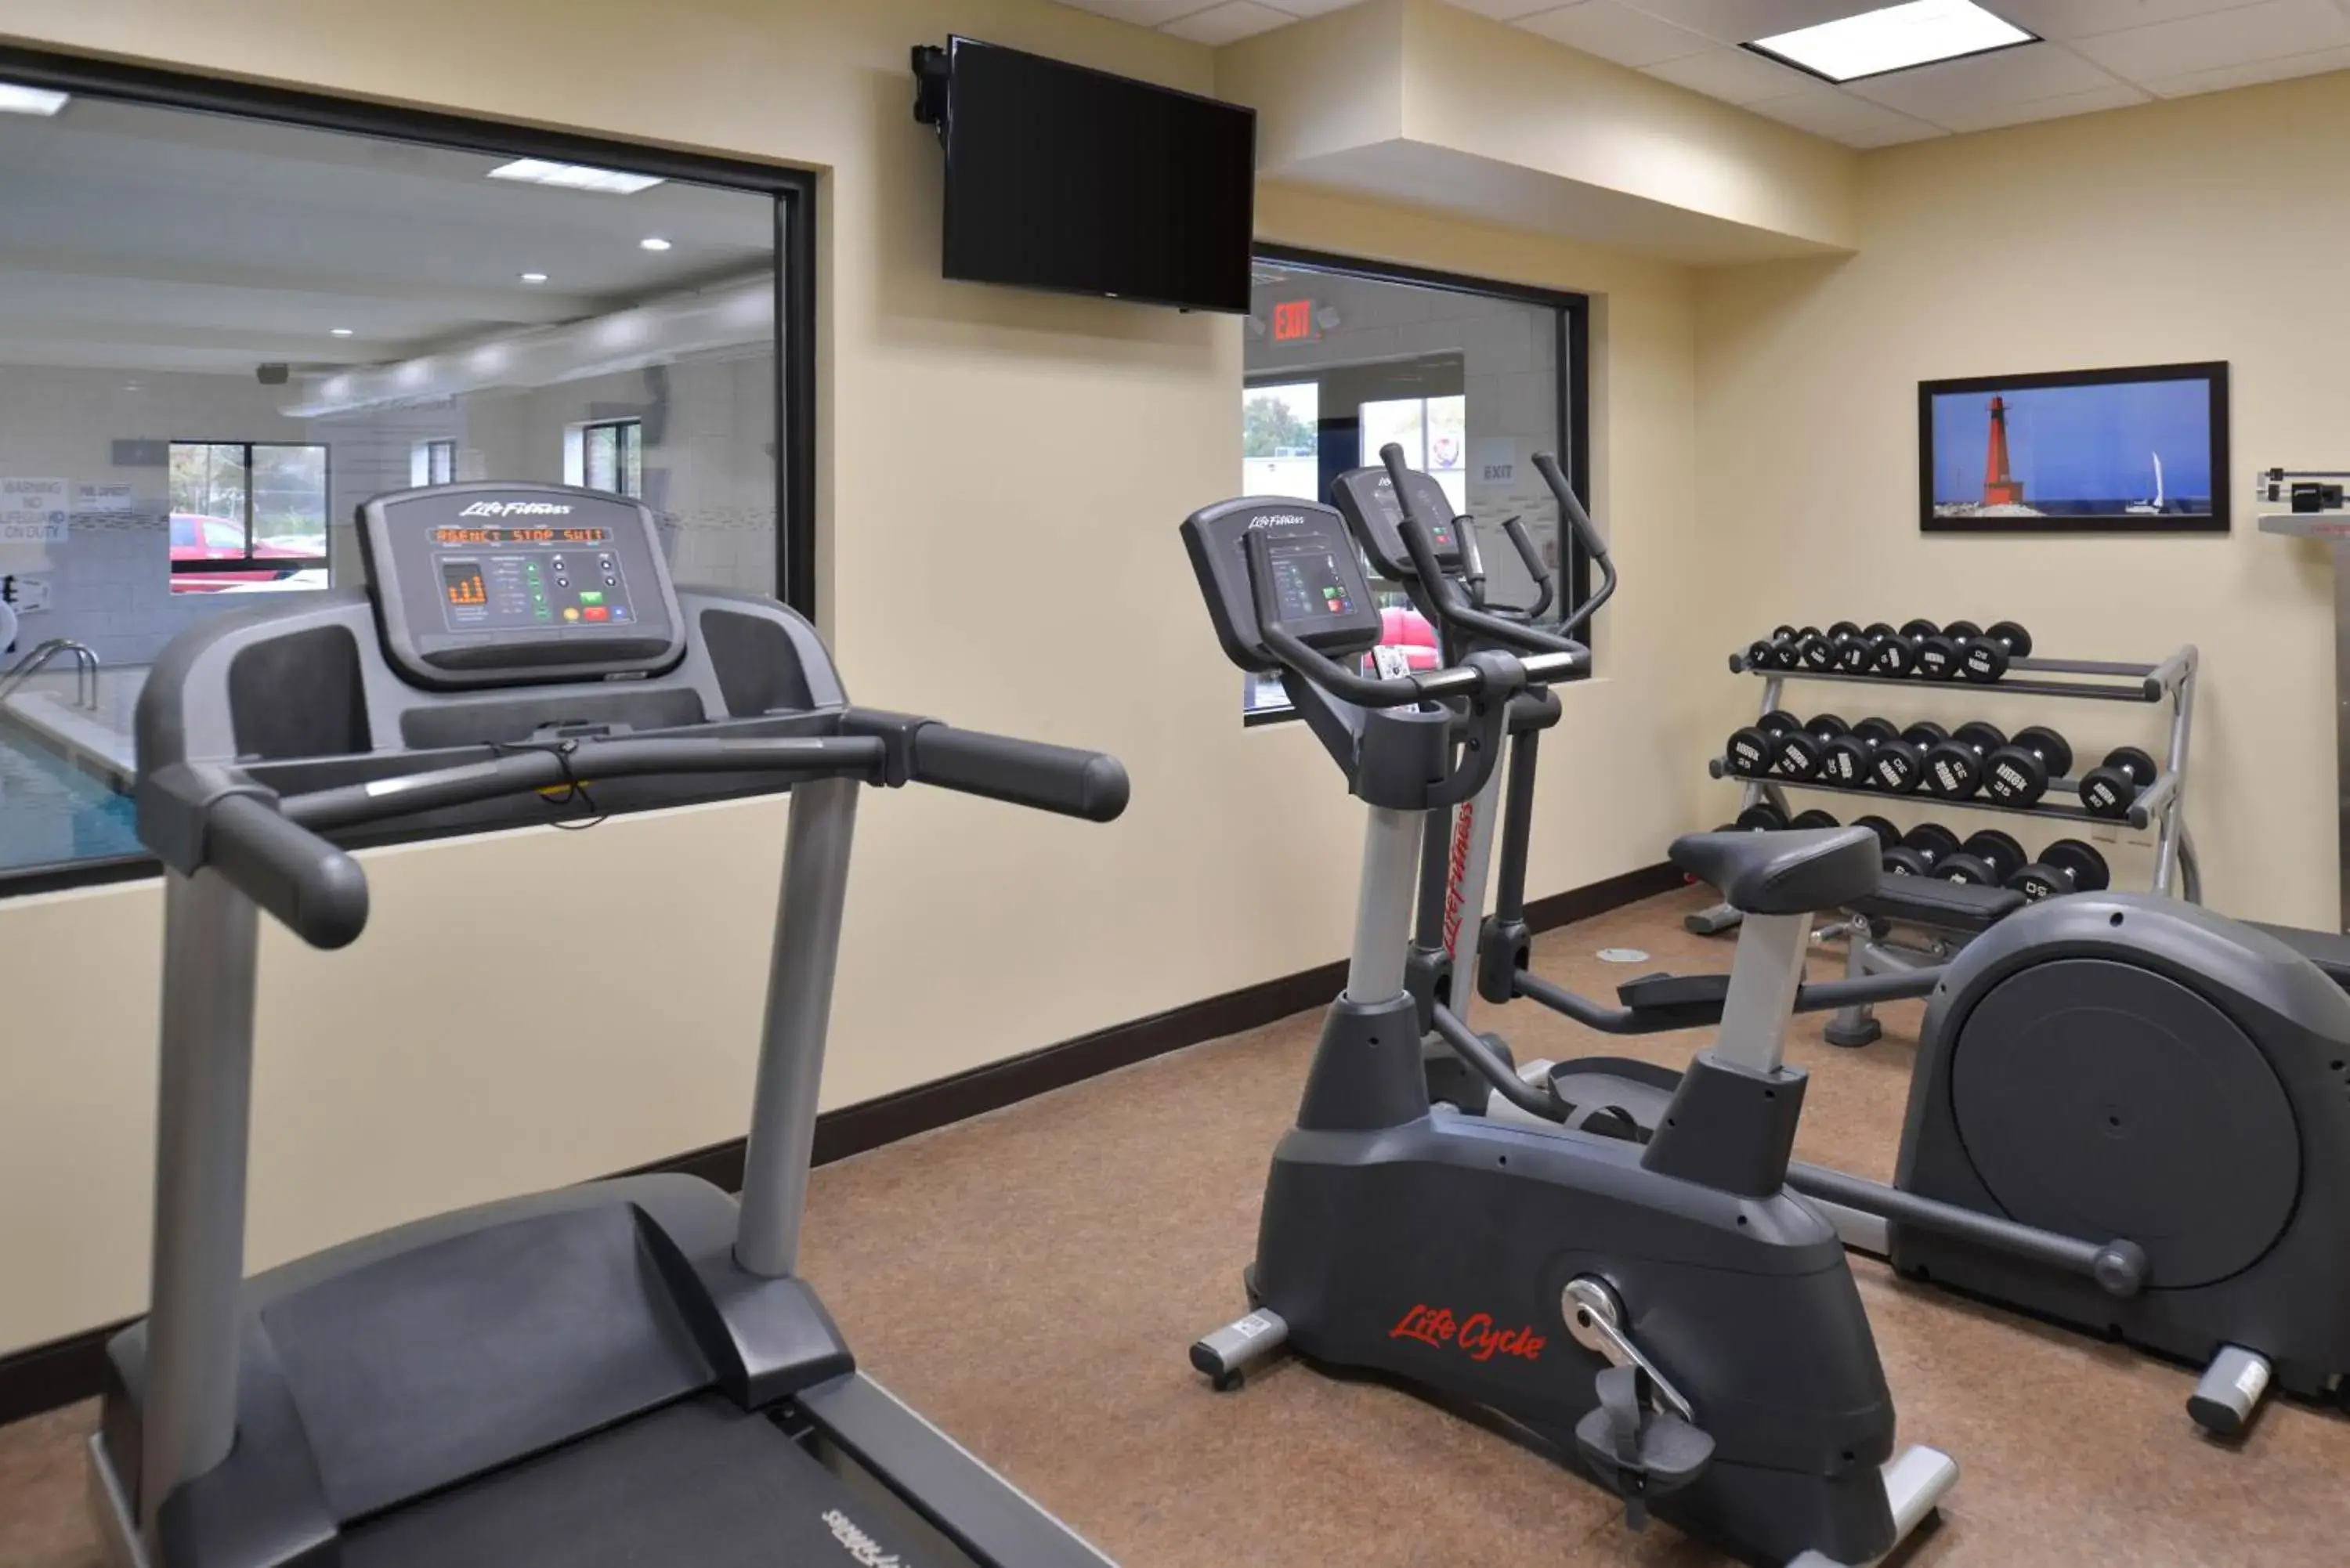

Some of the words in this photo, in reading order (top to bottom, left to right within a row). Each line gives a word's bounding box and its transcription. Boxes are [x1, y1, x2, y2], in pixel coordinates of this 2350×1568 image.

[1274, 301, 1311, 340] EXIT
[1484, 464, 1513, 480] EXIT
[23, 497, 42, 508] NO
[26, 526, 60, 538] DUTY
[1388, 1304, 1457, 1349] Life
[1458, 1313, 1547, 1360] Cycle
